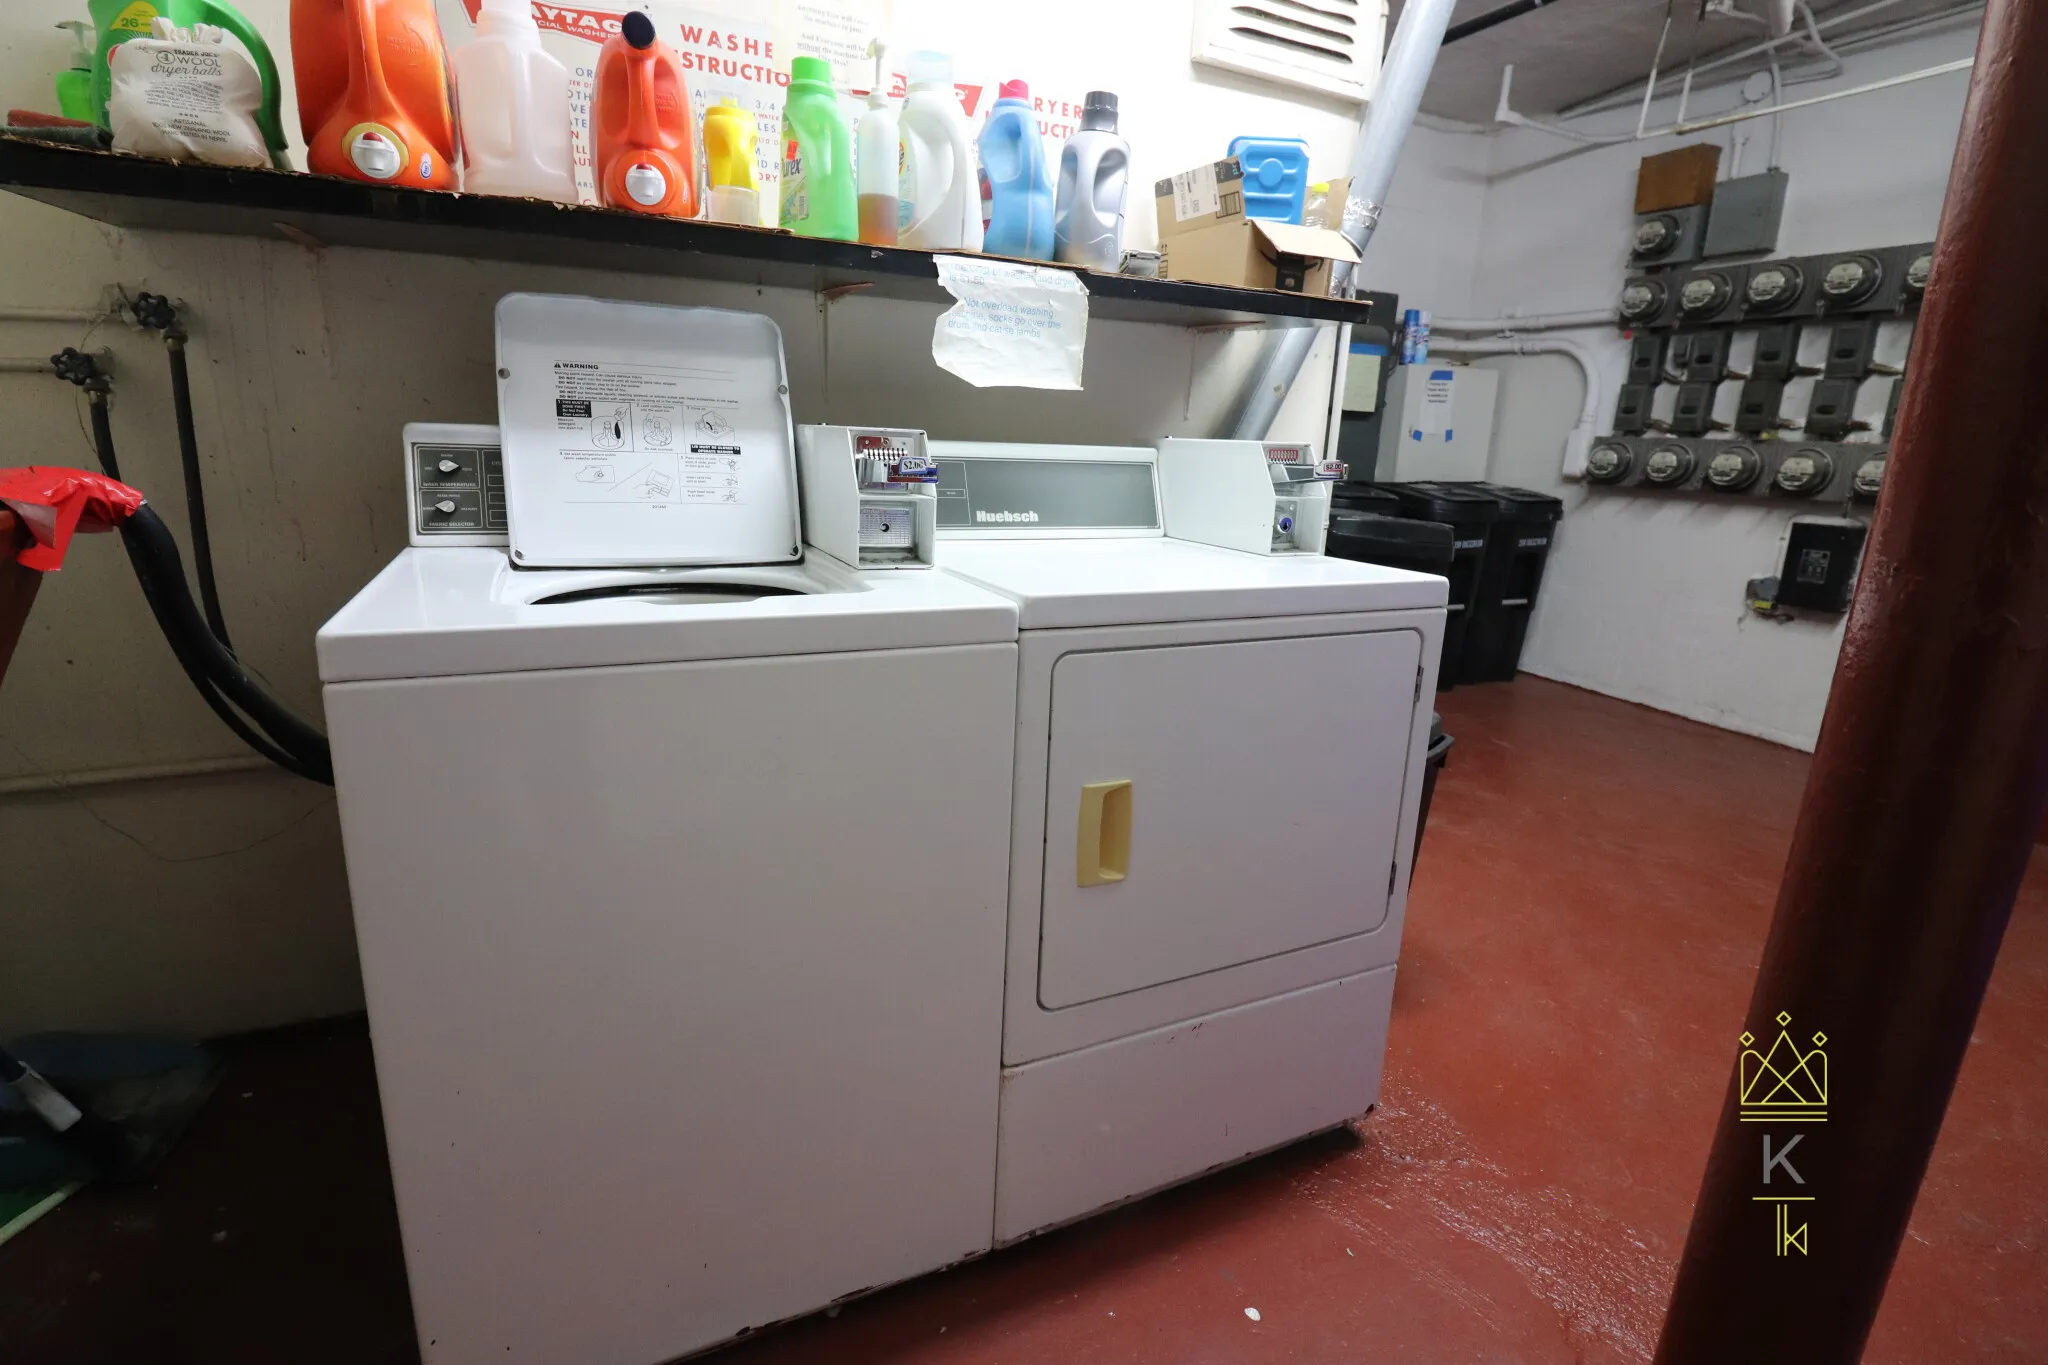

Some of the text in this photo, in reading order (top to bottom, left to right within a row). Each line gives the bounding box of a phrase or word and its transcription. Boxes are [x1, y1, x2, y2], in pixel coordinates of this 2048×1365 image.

[121, 18, 139, 27] 26
[174, 49, 199, 57] TRADER
[176, 56, 222, 68] WOOL
[676, 50, 791, 87] STRUCTIO
[152, 63, 224, 77] dryer balls
[756, 100, 775, 110] 3/4
[184, 126, 212, 134] ZEALAND
[781, 158, 802, 178] urex
[964, 297, 1054, 320] Not overload washing
[951, 311, 1062, 329] achine, socks go over the
[949, 319, 970, 329] drum
[990, 324, 1014, 335] cause
[1016, 327, 1041, 338] jambs
[976, 510, 1039, 522] Huebsch
